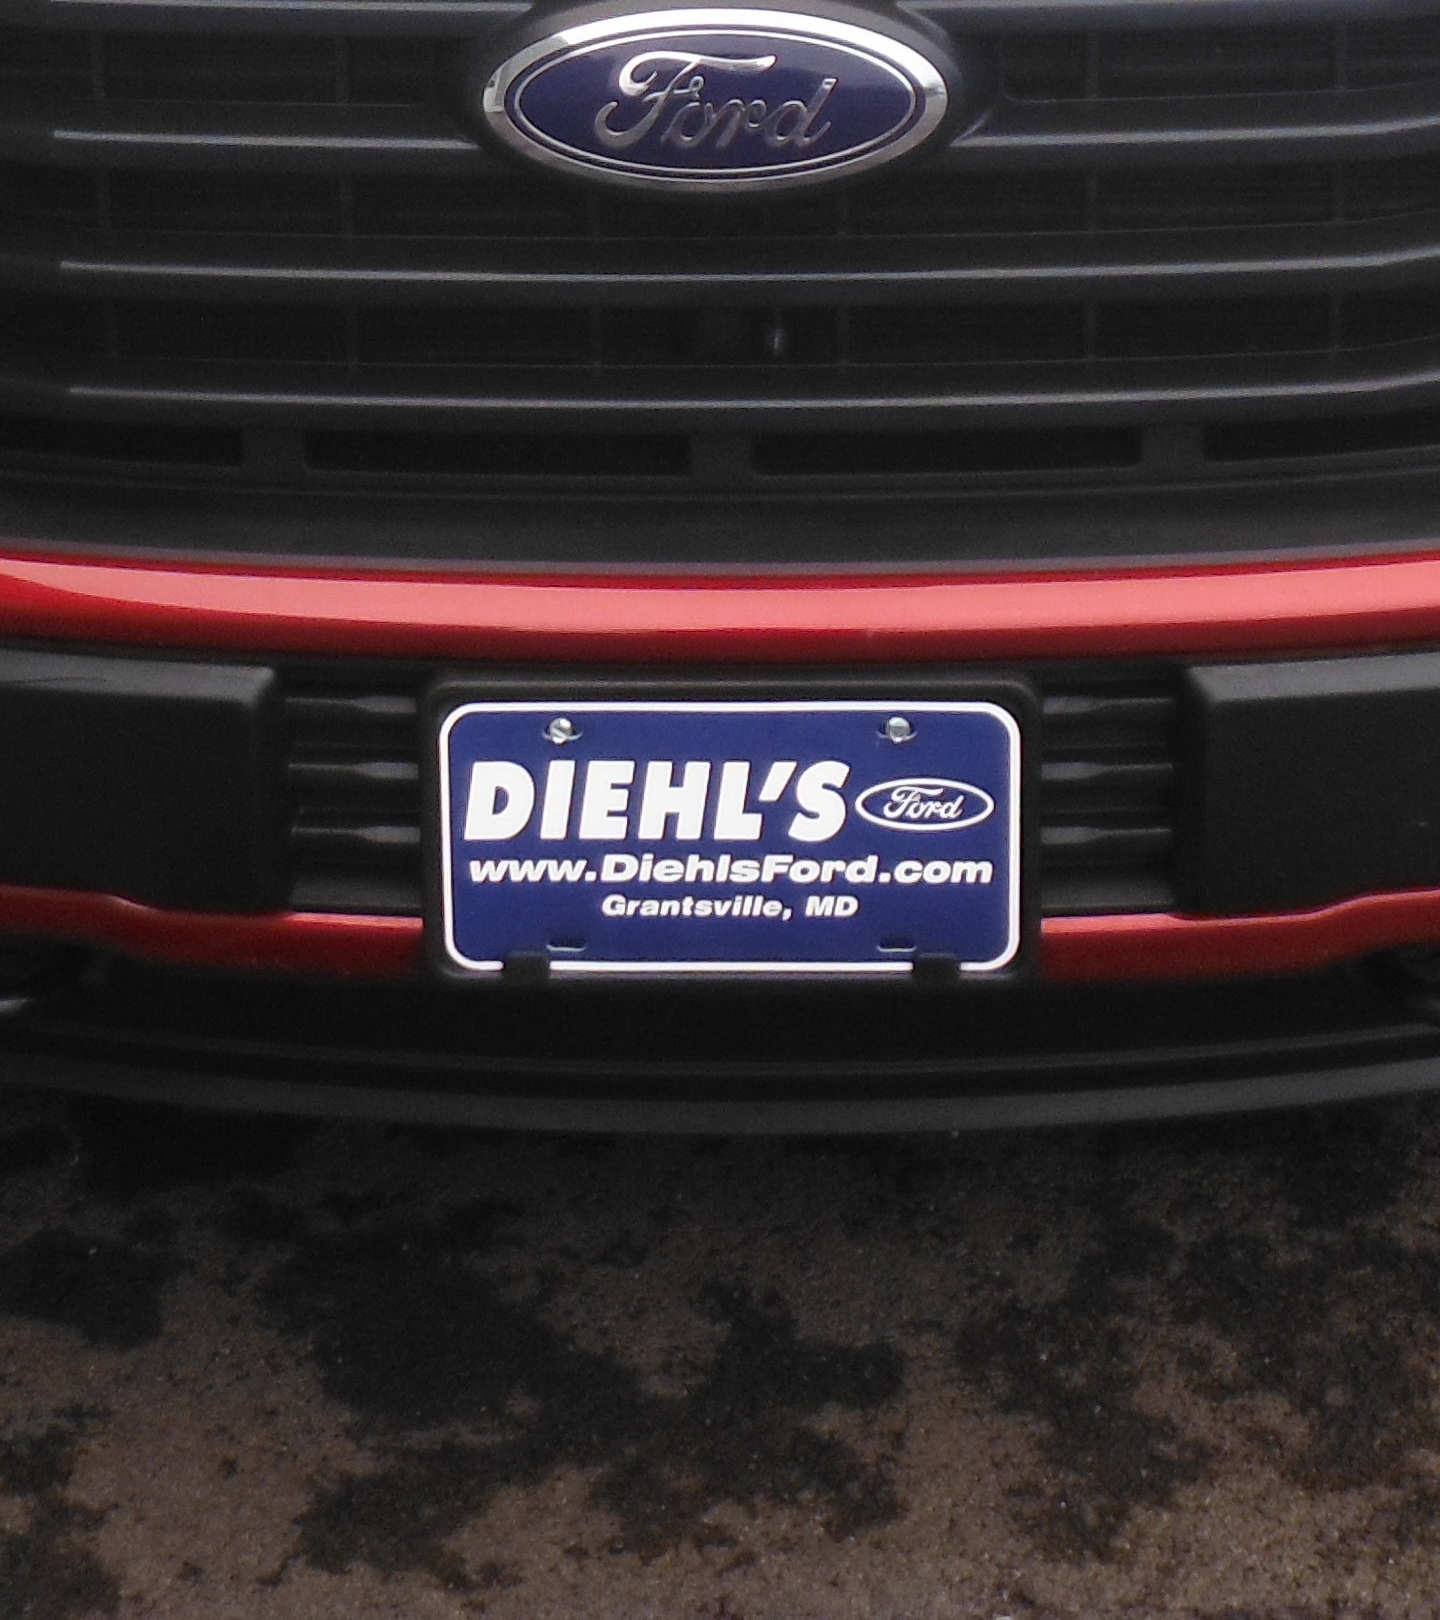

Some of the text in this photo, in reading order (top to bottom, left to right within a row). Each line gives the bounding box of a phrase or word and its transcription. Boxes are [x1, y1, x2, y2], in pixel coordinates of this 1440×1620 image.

[594, 49, 839, 150] Ford
[463, 759, 850, 843] DIEHL'S
[881, 784, 964, 822] Ford
[468, 853, 993, 885] www.DiehlsFord.com
[601, 894, 859, 921] Grantsville, MD
